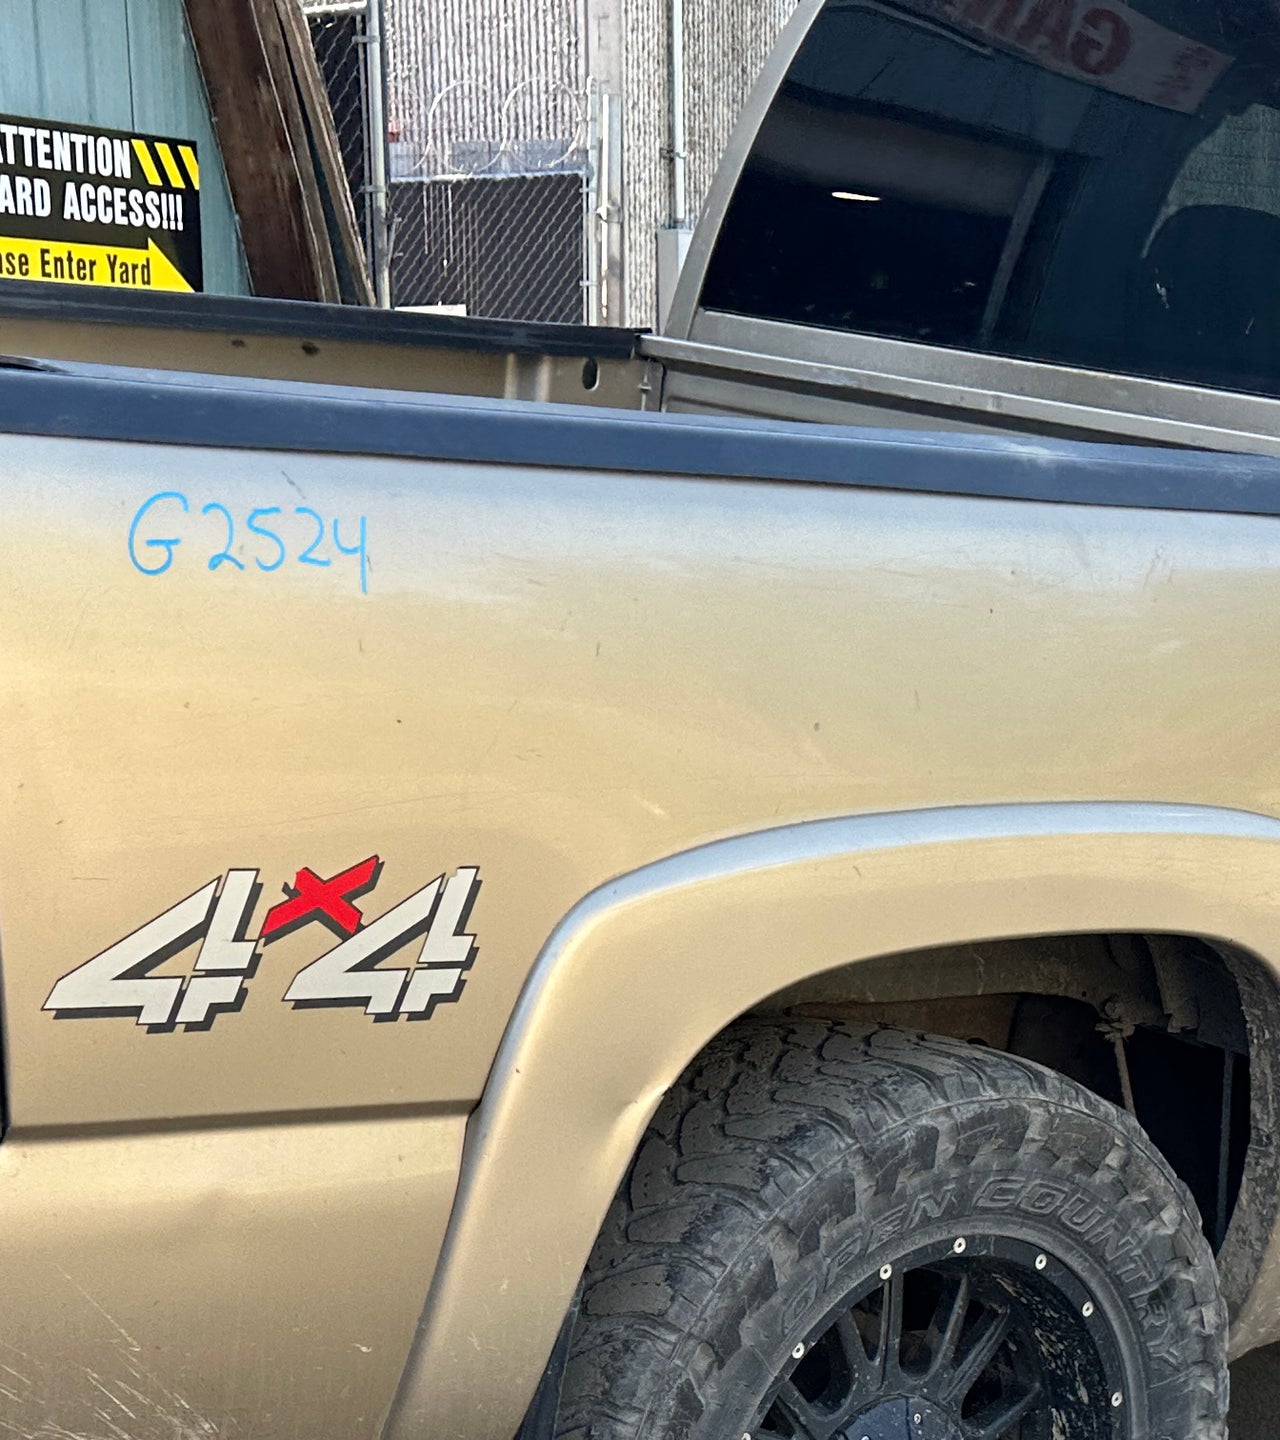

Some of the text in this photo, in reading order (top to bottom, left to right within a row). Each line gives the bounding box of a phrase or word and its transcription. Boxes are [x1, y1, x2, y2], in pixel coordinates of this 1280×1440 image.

[63, 181, 185, 232] ACCESS!!!
[40, 248, 98, 283] Enter
[106, 253, 152, 287] Yard
[127, 490, 368, 596] G2524
